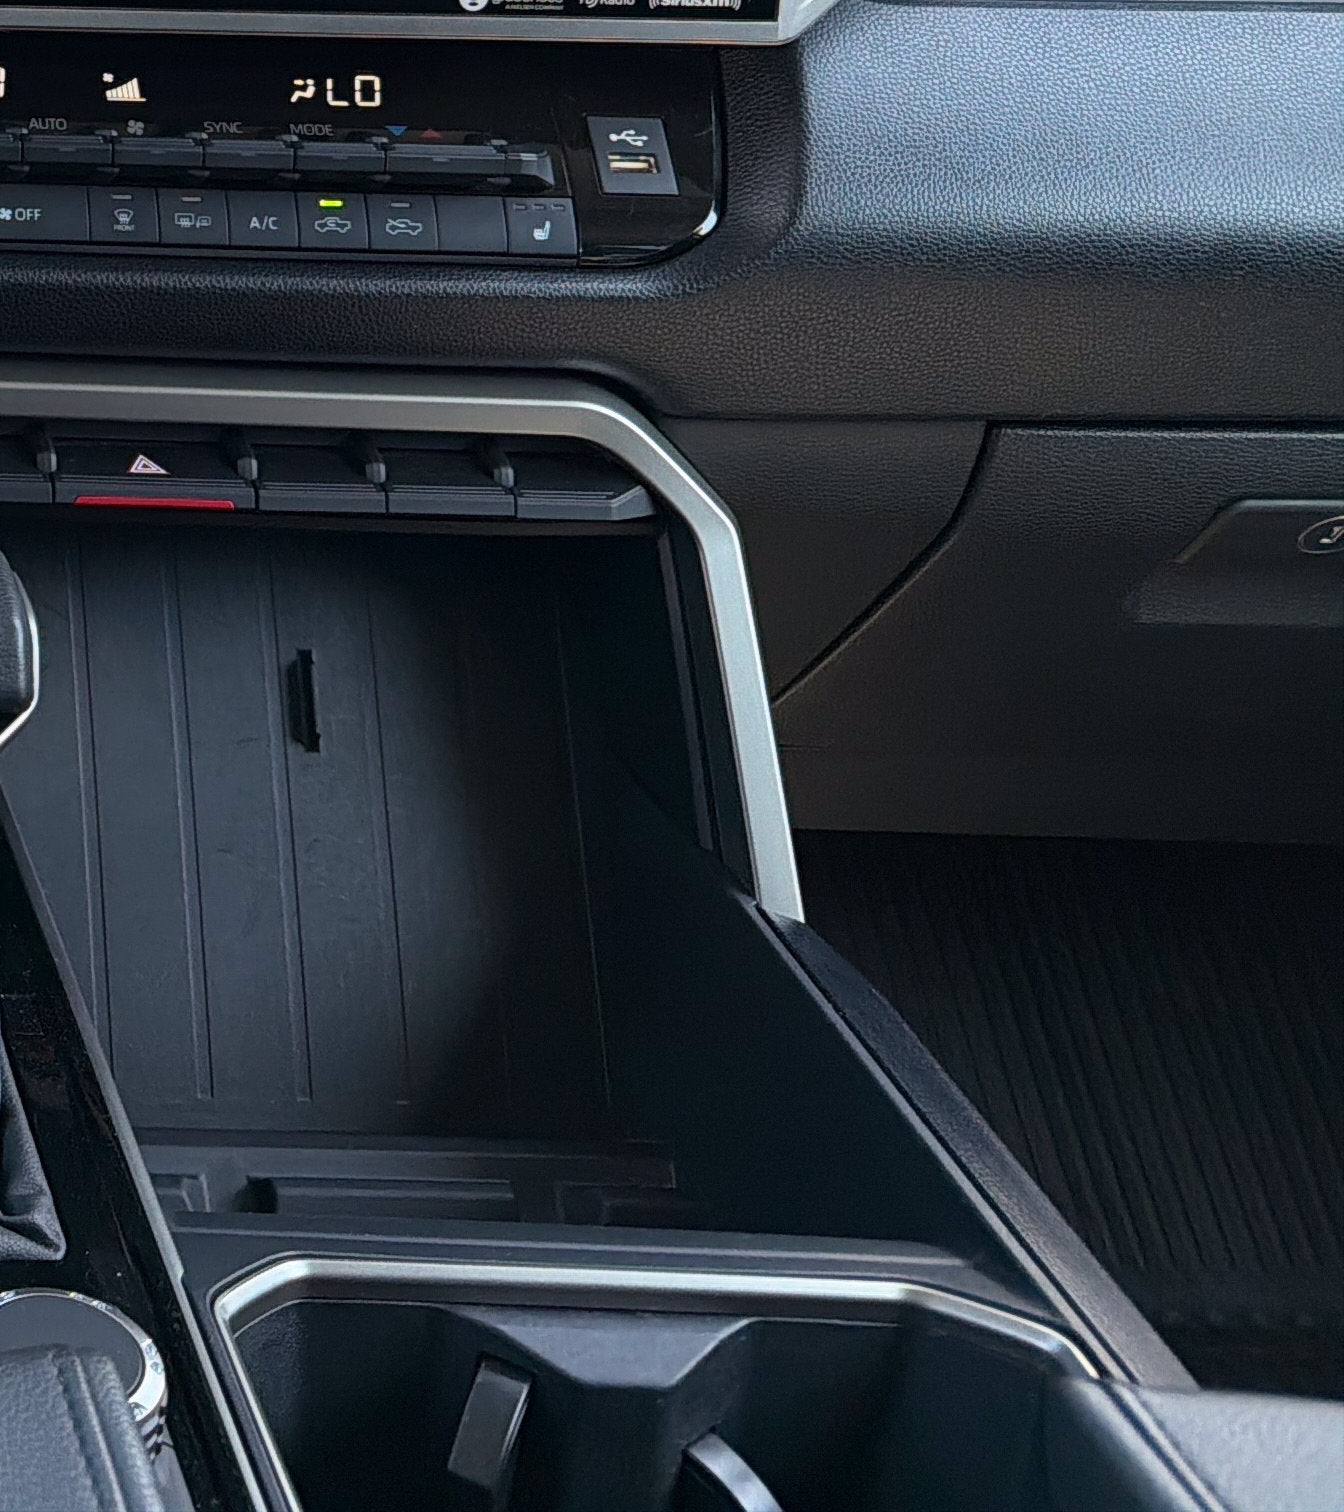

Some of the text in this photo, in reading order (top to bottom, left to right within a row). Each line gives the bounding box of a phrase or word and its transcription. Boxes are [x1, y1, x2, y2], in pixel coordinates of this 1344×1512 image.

[326, 75, 381, 107] LO
[29, 117, 67, 131] AUTO
[203, 121, 243, 133] SYNC
[290, 123, 333, 136] MODE
[15, 208, 41, 221] OFF
[249, 216, 278, 230] A/C
